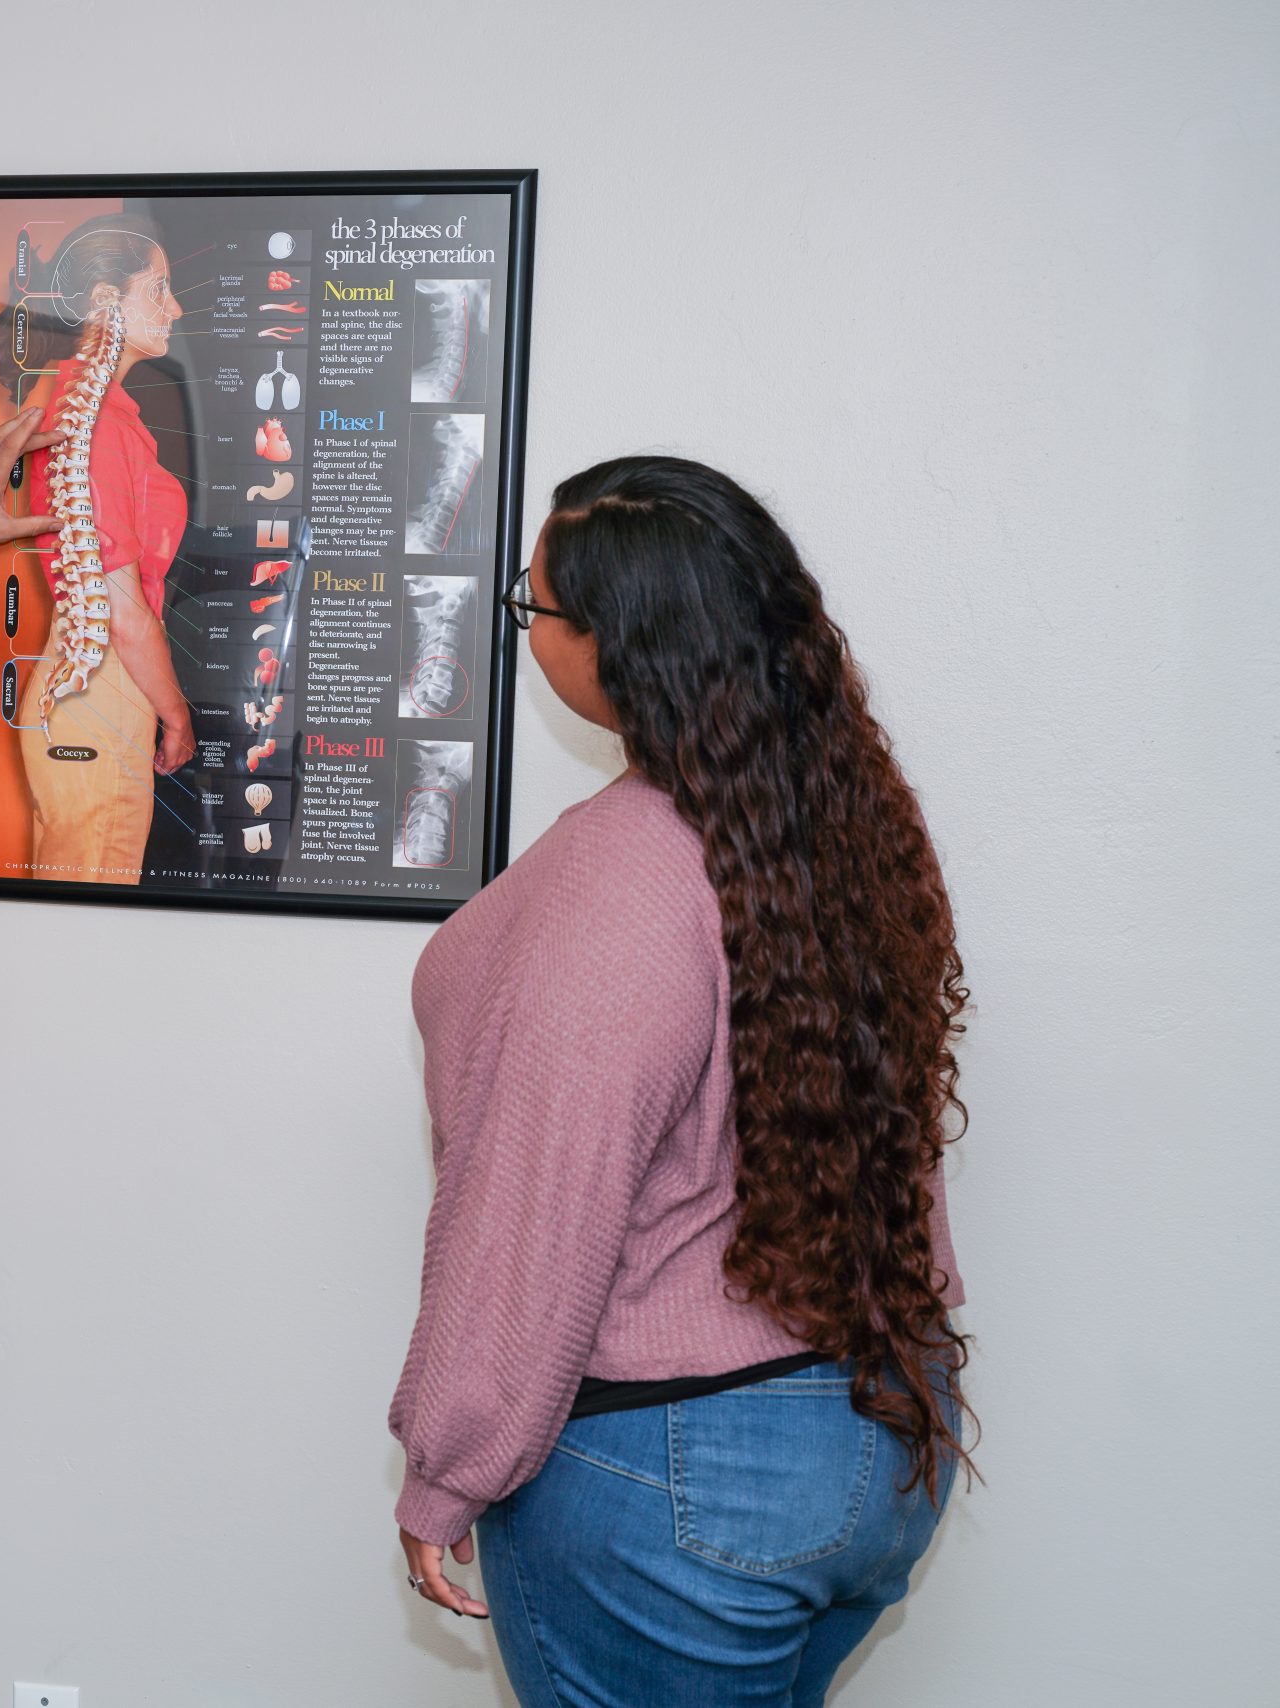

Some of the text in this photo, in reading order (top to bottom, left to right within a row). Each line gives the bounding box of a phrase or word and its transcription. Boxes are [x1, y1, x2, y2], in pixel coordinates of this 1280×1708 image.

[331, 216, 467, 245] the 3 phases of
[19, 240, 27, 276] Cranial
[325, 242, 495, 270] spinal degeneration
[324, 280, 394, 301] Normal
[322, 309, 331, 317] In
[342, 309, 380, 317] textbook
[322, 321, 402, 330] mal spine, the disc
[17, 313, 25, 353] Cervical
[321, 334, 349, 342] spaces
[367, 332, 392, 342] equal
[351, 355, 371, 364] signs
[375, 355, 384, 363] of
[320, 366, 374, 376] degenerative
[319, 378, 355, 387] changes.
[319, 410, 385, 431] Phase I
[326, 439, 351, 447] Phase
[360, 439, 368, 447] of
[371, 440, 397, 449] spinal
[313, 450, 386, 459] degeneration, the
[313, 461, 383, 471] alignment of the
[313, 473, 335, 481] spine
[347, 472, 378, 481] altered,
[366, 483, 382, 491] disc
[312, 495, 338, 503] spaces
[341, 495, 359, 503] may
[347, 505, 392, 515] Symptoms
[330, 516, 382, 526] degenerative
[313, 570, 386, 592] Phase II
[7, 587, 17, 625] Lumbar
[310, 619, 350, 629] alignment
[320, 630, 364, 639] deteriorate,
[309, 640, 324, 648] disc
[327, 641, 367, 651] narrowing
[309, 652, 340, 660] present.
[309, 662, 359, 671] Degenerative
[308, 673, 339, 682] changes
[342, 675, 374, 684] progress
[5, 677, 14, 706] Sacral
[330, 685, 351, 693] spurs
[368, 686, 383, 694] pre-
[329, 694, 352, 702] Nerve
[354, 695, 380, 703] tissues
[307, 715, 327, 724] begin
[340, 717, 372, 726] atrophy.
[305, 735, 384, 758] Phase III
[56, 749, 90, 758] Coccyx
[317, 763, 342, 771] Phase
[304, 774, 374, 785] spinal degenera-
[304, 786, 323, 794] tion,
[342, 787, 363, 796] joint
[303, 808, 373, 817] visualized. Bone
[303, 820, 325, 828] spurs
[329, 821, 363, 830] progress
[303, 829, 320, 838] fuse
[339, 831, 376, 840] involved
[301, 841, 379, 851] joint. Nerve tissue
[301, 853, 366, 862] atrophy occurs.
[5, 863, 83, 872] CHIROPRACTIC
[90, 867, 143, 875] WELLNESS
[163, 870, 206, 878] FITNESS
[213, 873, 270, 881] MAGAZINE
[314, 878, 367, 886] 640-1089
